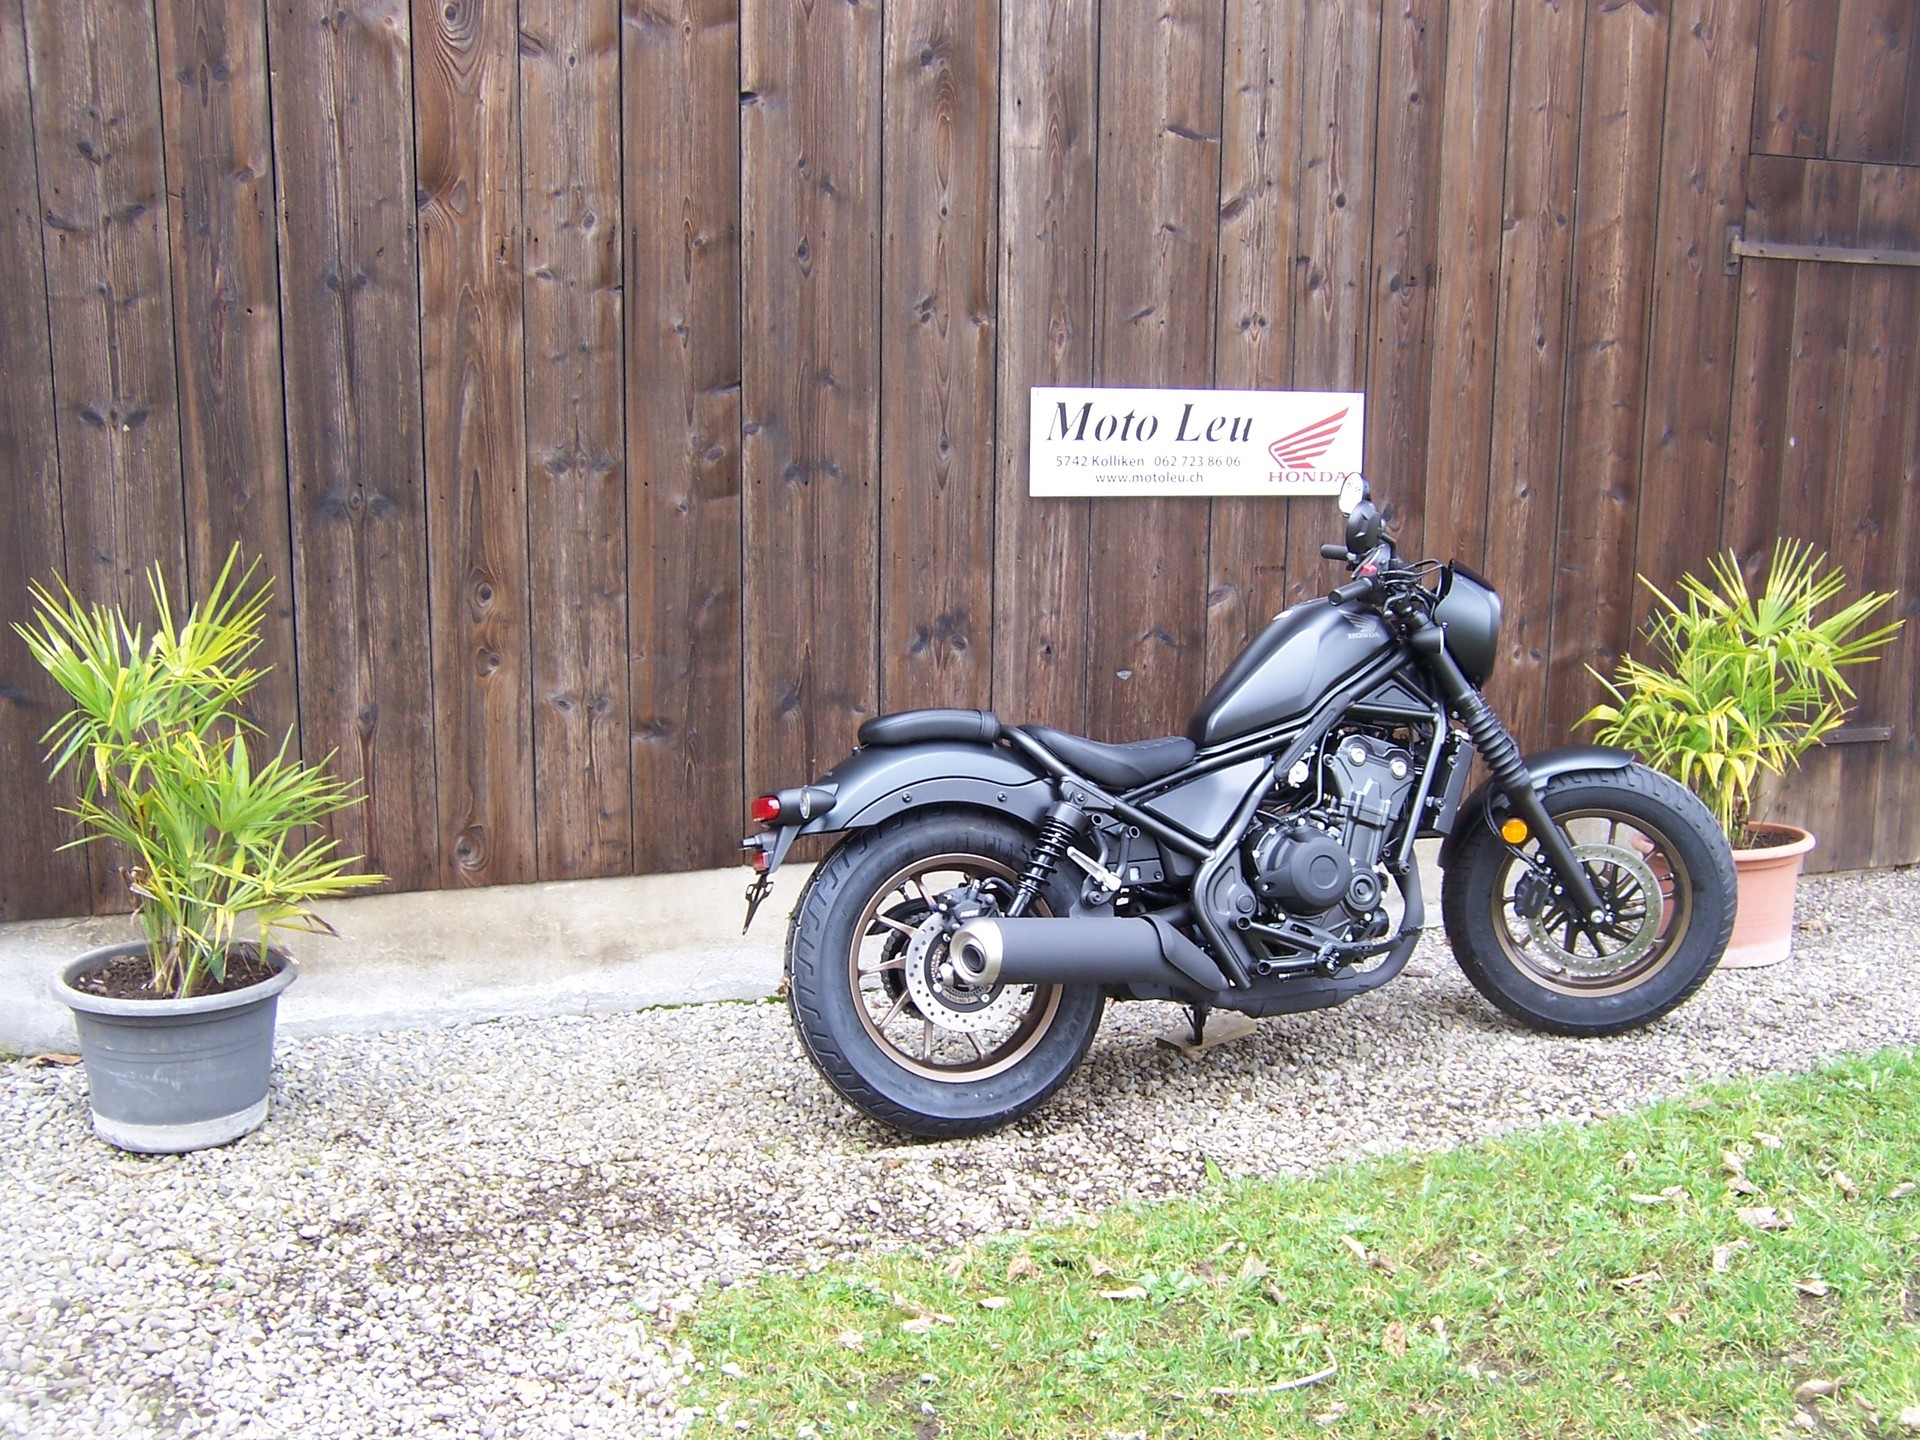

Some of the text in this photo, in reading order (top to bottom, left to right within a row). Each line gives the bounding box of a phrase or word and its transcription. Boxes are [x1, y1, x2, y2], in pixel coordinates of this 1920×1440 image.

[1046, 401, 1254, 443] Moto Leu
[1056, 455, 1088, 467] 5742
[1154, 455, 1177, 467] 062
[1181, 455, 1204, 467] 723
[1207, 456, 1223, 467] 86
[1225, 456, 1241, 467] 06
[1095, 471, 1204, 483] www.motoleu.ch
[1268, 471, 1348, 483] HONDA
